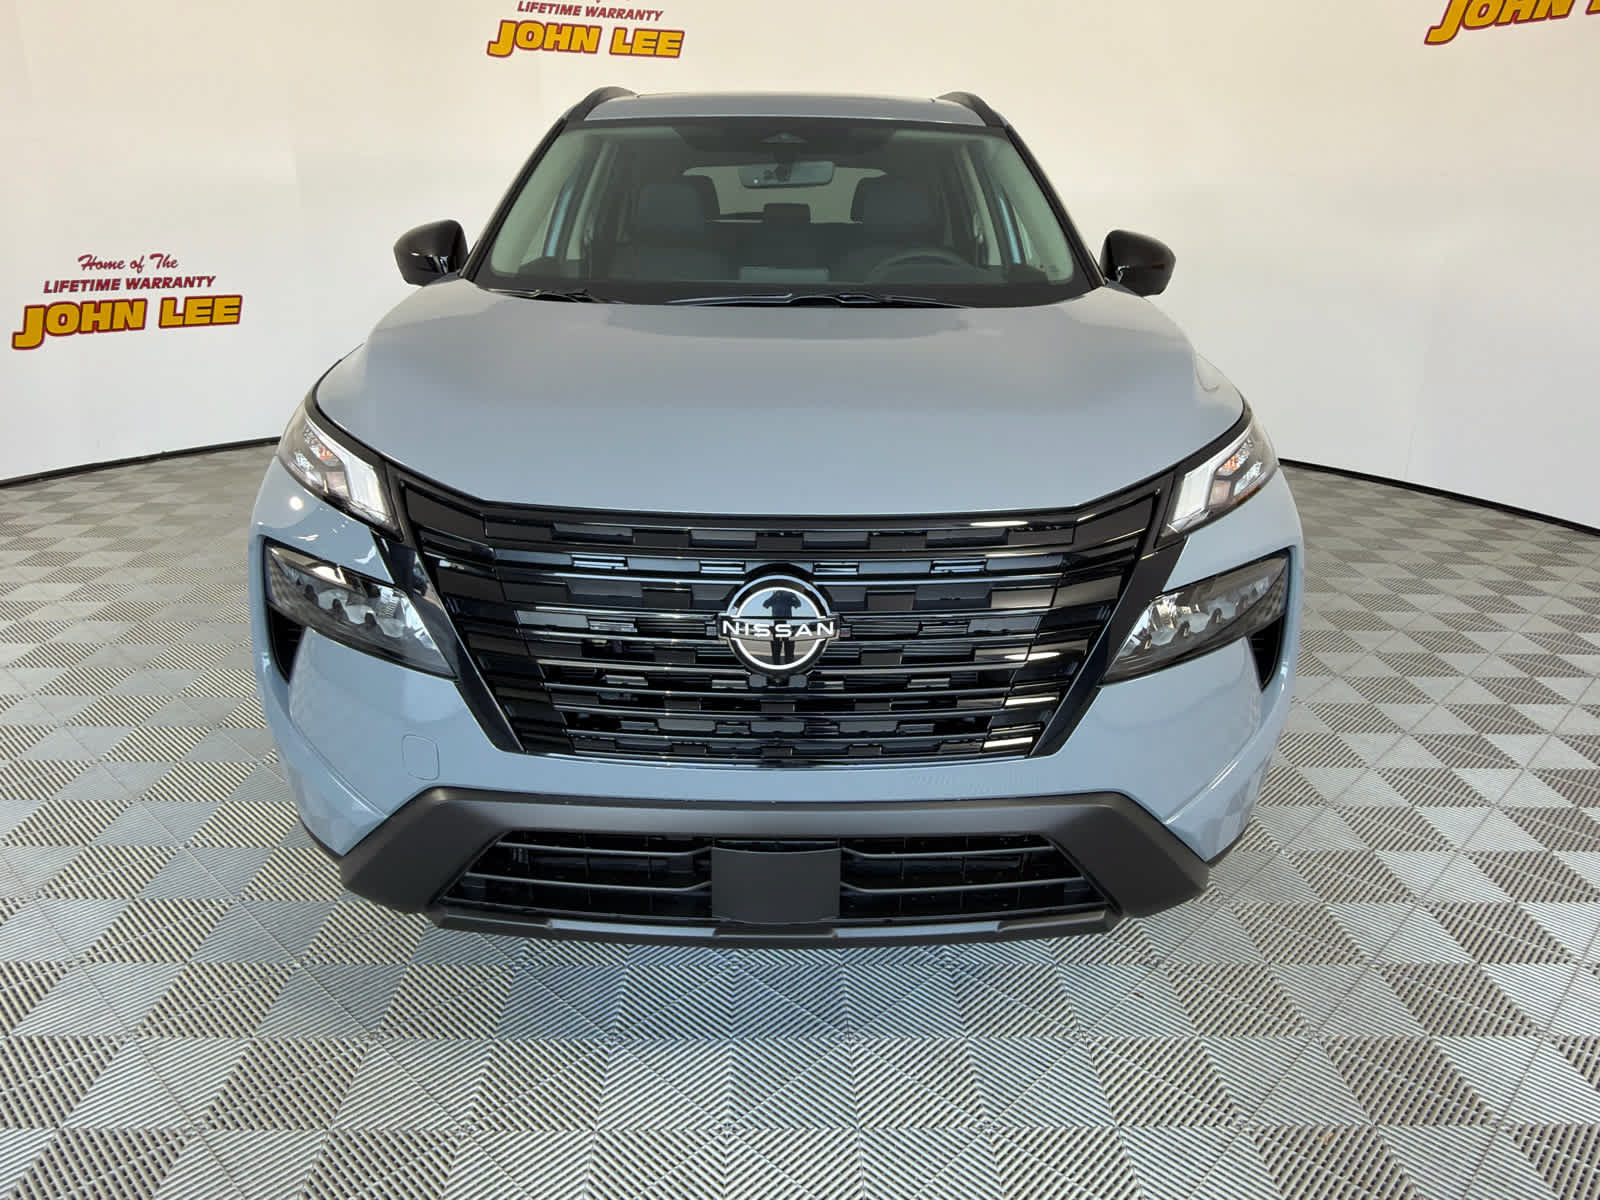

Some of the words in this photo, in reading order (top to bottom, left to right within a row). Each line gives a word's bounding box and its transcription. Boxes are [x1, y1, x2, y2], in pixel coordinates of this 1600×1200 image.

[517, 1, 582, 16] LIFETIME
[585, 6, 664, 21] WARRANTY
[1424, 0, 1576, 45] JOHN
[487, 20, 602, 58] JOHN
[609, 27, 685, 58] LEE
[78, 254, 125, 271] Home
[130, 256, 145, 273] of
[149, 253, 178, 269] The
[43, 279, 121, 294] LIFETIME
[125, 275, 216, 291] WARRANTY
[11, 298, 148, 350] JOHN
[158, 295, 243, 328] LEE
[722, 620, 835, 637] NISSAN
